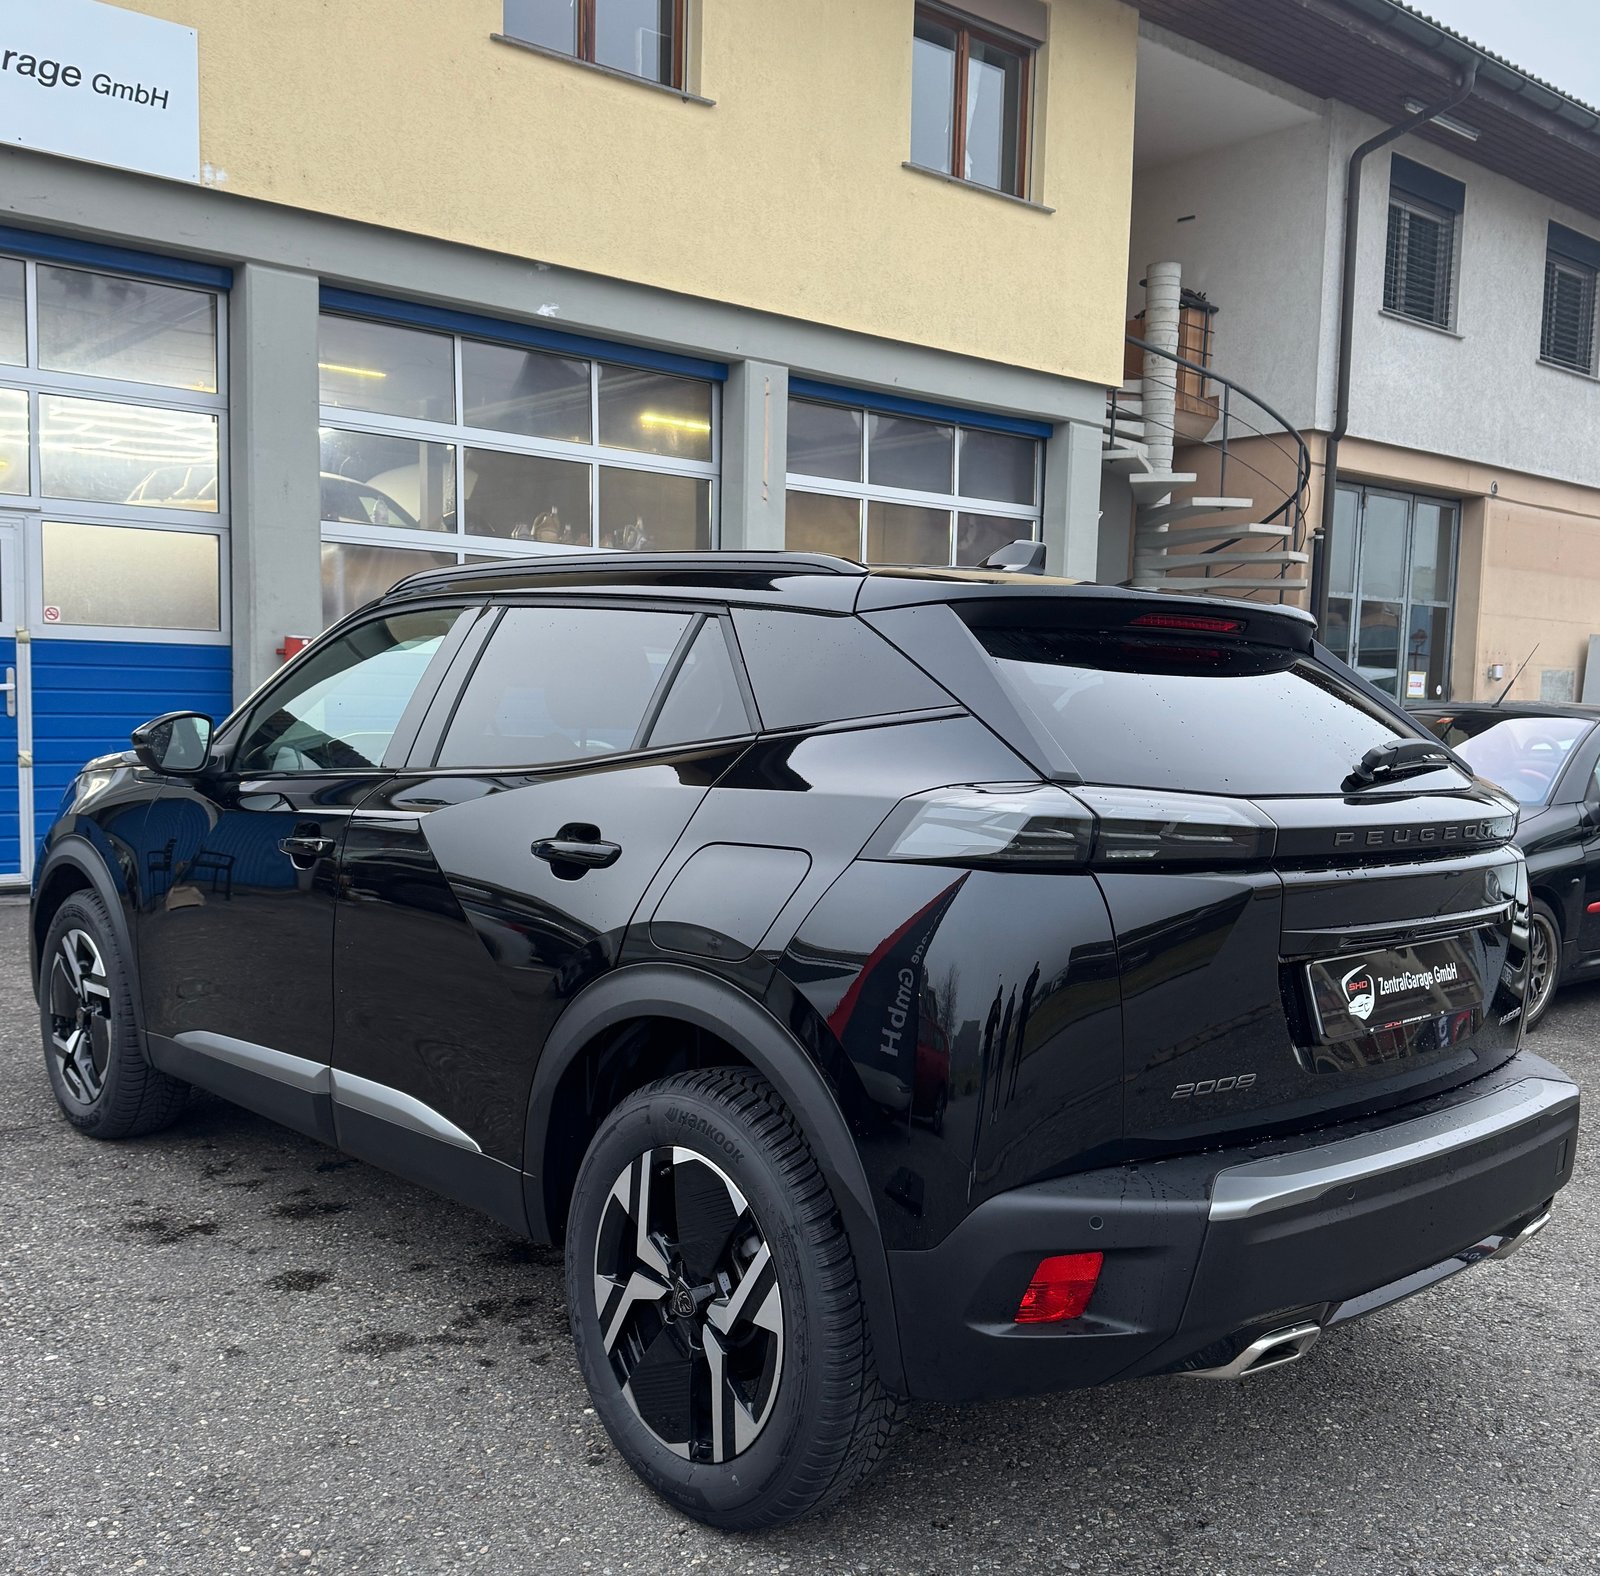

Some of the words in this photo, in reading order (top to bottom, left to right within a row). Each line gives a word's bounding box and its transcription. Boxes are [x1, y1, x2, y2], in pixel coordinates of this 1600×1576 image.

[92, 73, 169, 110] GmbH
[1333, 822, 1495, 847] PEUGEOT
[1378, 970, 1434, 995] ZentralGarage
[1433, 962, 1458, 983] GmbH
[1171, 1073, 1257, 1100] 2008
